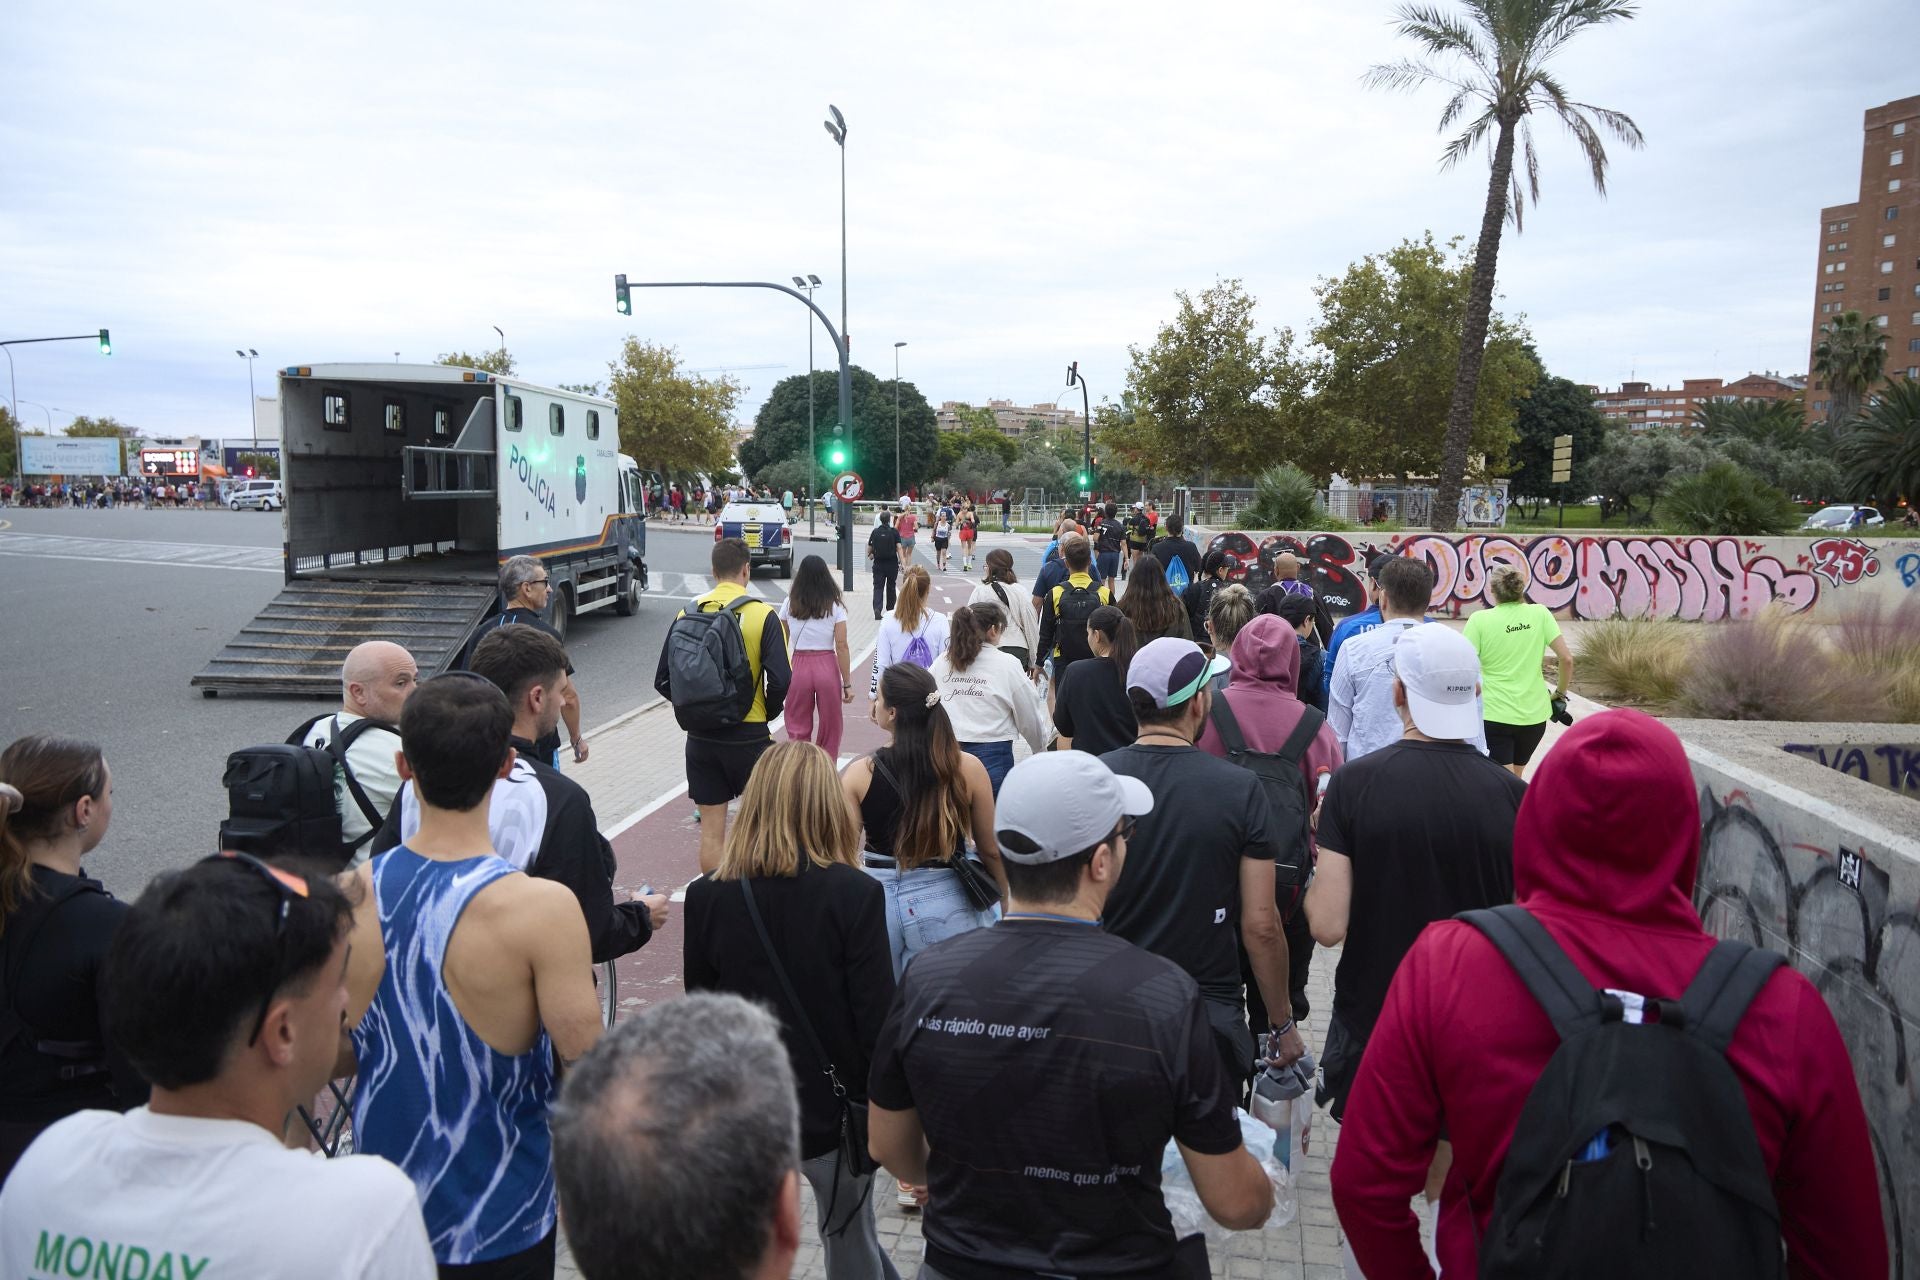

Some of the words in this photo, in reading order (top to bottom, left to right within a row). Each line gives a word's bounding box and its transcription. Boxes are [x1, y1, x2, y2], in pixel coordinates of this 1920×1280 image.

[1505, 623, 1531, 633] Sandra
[943, 1017, 985, 1036] rápido
[987, 1023, 1015, 1038] que
[1017, 1026, 1051, 1041] ayer
[1023, 1166, 1071, 1181] menos
[1073, 1173, 1100, 1186] que
[34, 1230, 211, 1280] MONDAY
